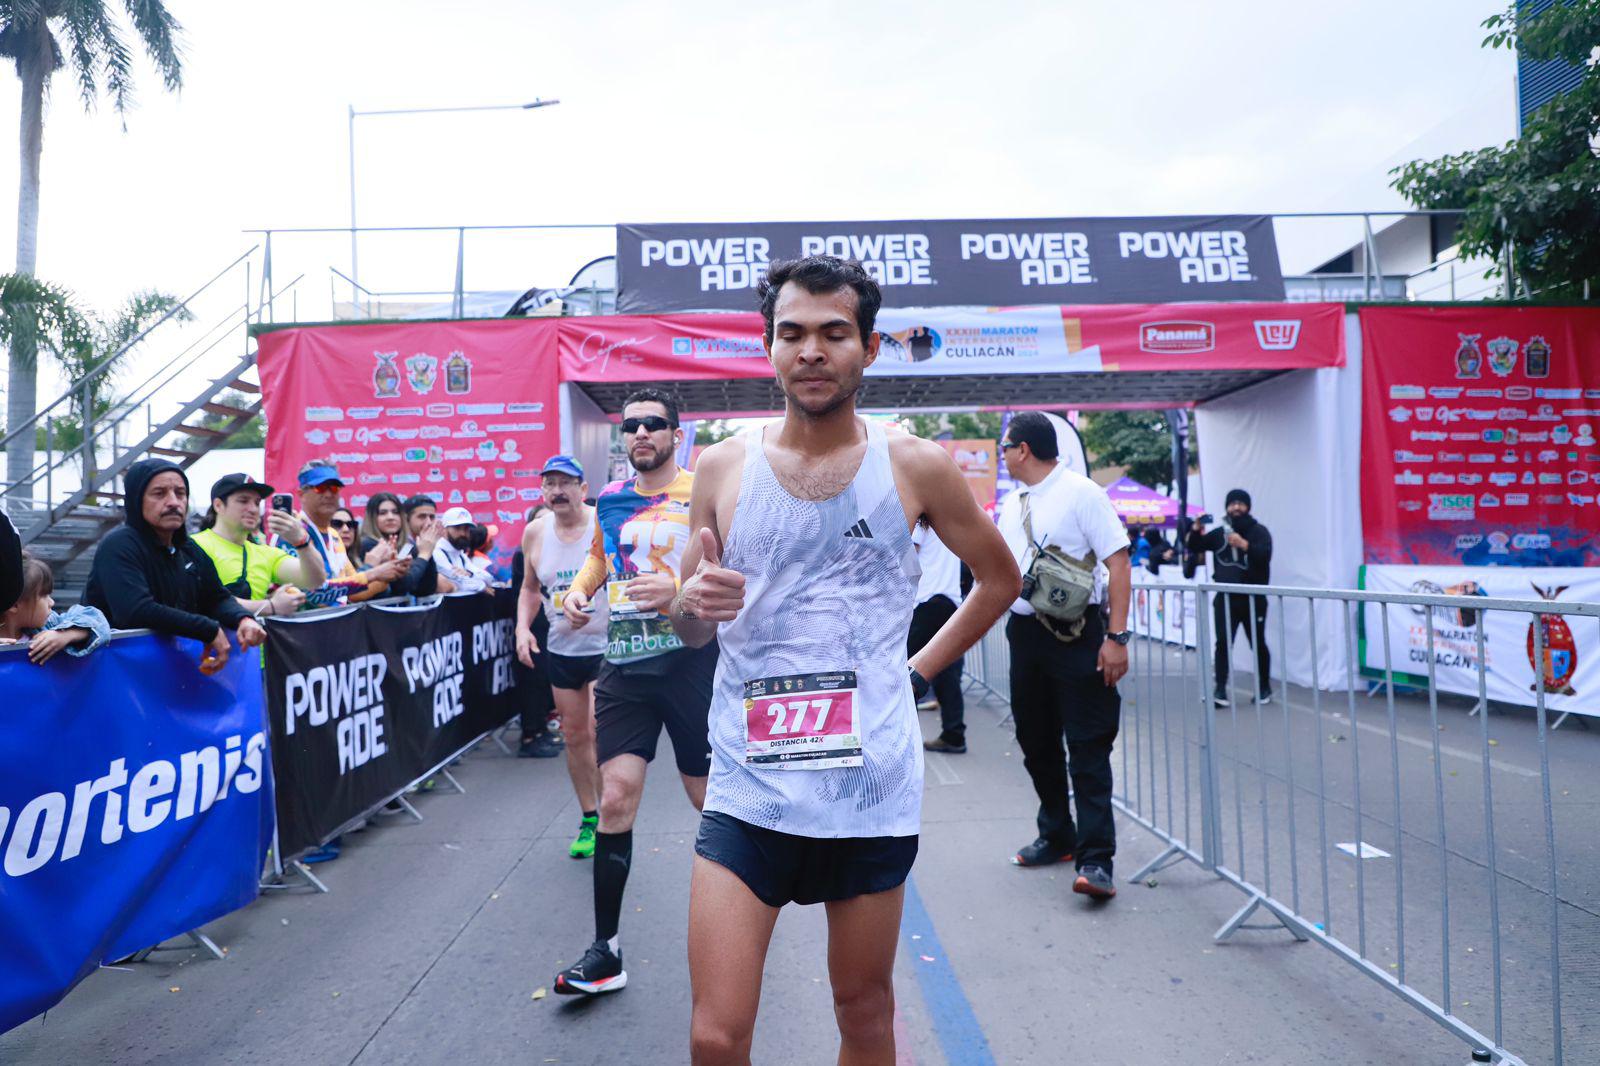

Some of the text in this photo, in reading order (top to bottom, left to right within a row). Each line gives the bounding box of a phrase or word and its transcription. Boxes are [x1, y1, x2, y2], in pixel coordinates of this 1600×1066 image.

[641, 237, 770, 266] POWER
[801, 234, 930, 260] POWER
[961, 233, 1088, 259] POWER
[1119, 231, 1248, 257] POWER
[1021, 258, 1092, 285] ADE
[1179, 256, 1250, 283] ADE
[694, 337, 764, 352] WYNDHA
[1147, 326, 1207, 341] Panamá
[402, 631, 464, 694] POWER
[286, 653, 388, 735] POWER
[433, 673, 465, 728] ADE
[767, 698, 833, 735] 277
[337, 704, 387, 776] ADE
[770, 737, 807, 748] DISTANCIA
